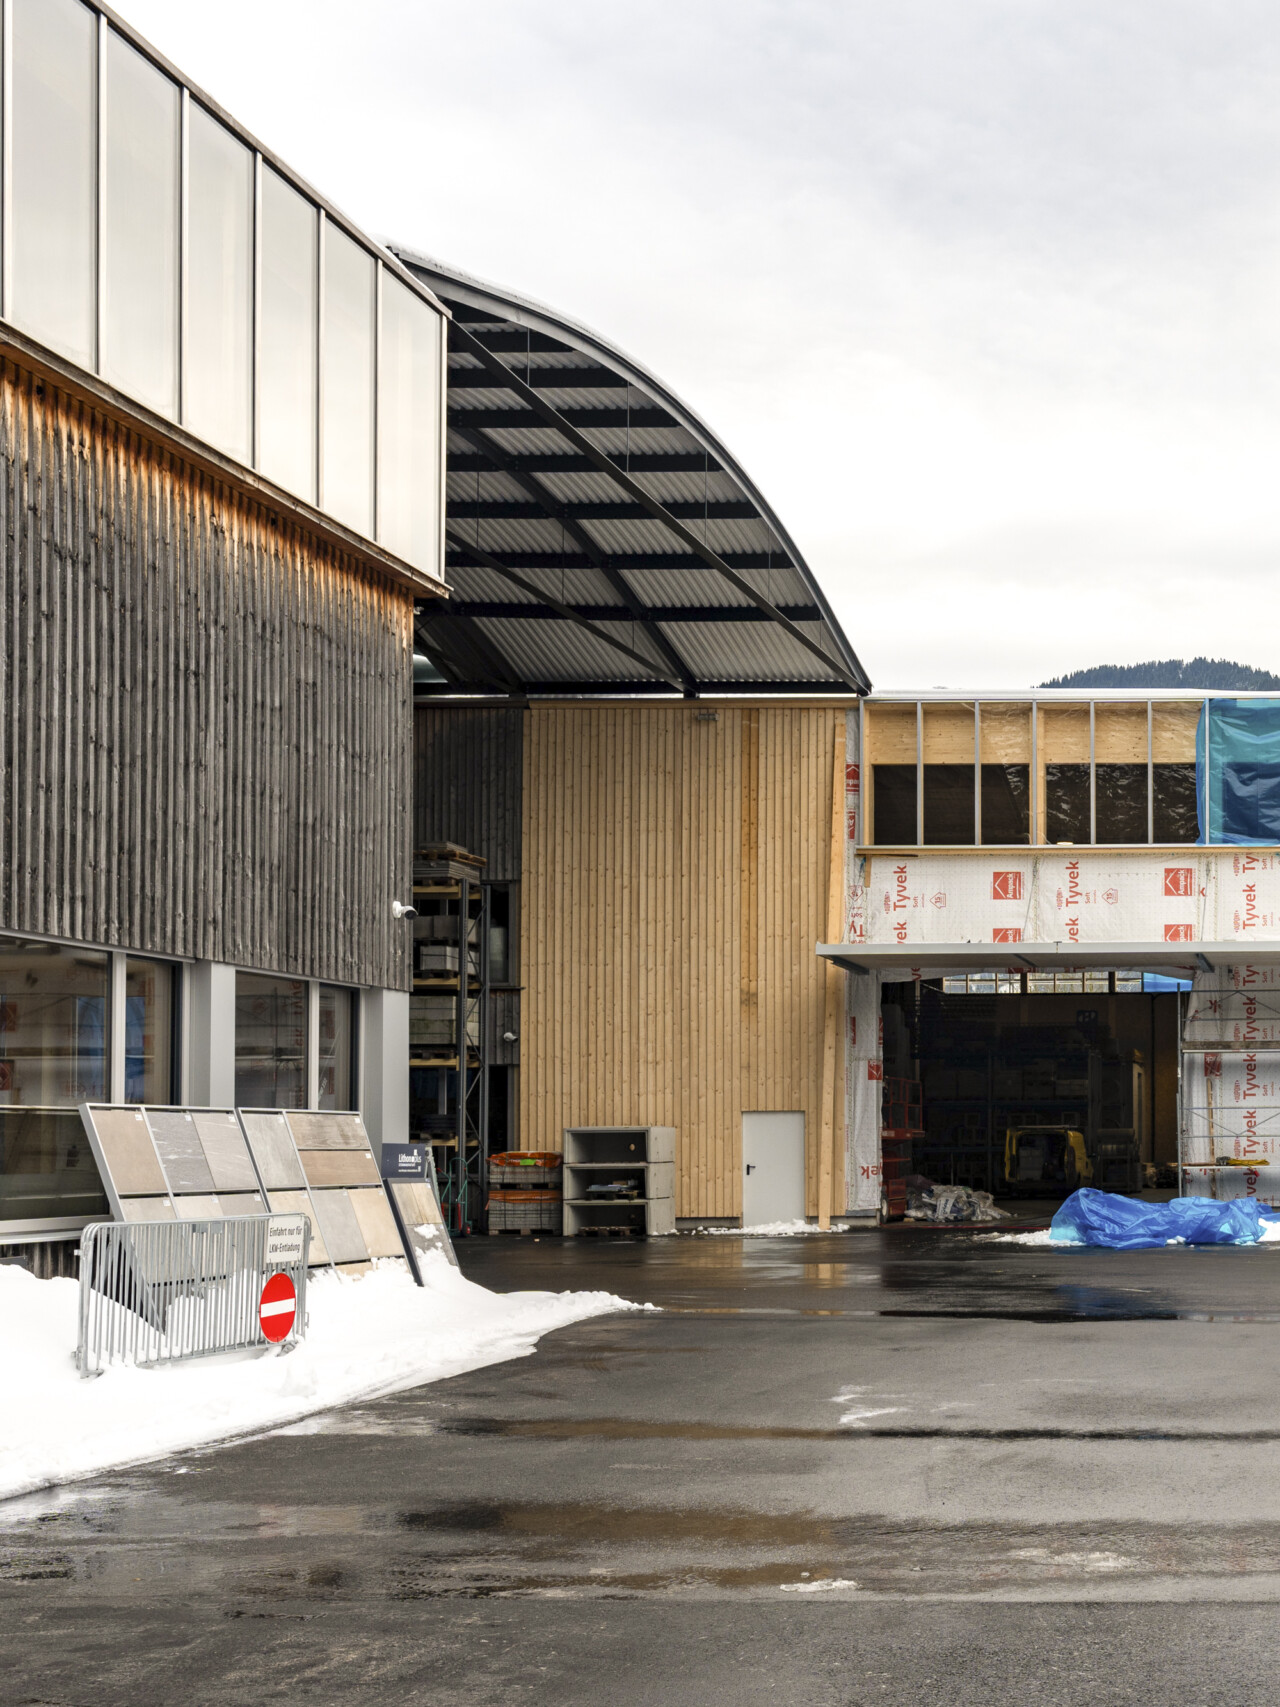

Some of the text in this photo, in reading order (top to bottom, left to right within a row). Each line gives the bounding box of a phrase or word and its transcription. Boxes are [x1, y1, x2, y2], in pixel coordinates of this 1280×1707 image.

[893, 865, 910, 911] Tyvek
[1006, 873, 1015, 898] Ampack
[1066, 861, 1082, 907] Tyvek
[1178, 869, 1187, 895] Ampack
[1243, 884, 1259, 930] Tyvek
[1065, 918, 1079, 942] vek
[1243, 997, 1260, 1041] Tyvek
[1243, 1054, 1260, 1100] Tyvek
[1243, 1110, 1260, 1156] Tyvek
[269, 1243, 300, 1253] LKW-Entladung
[270, 1227, 287, 1236] Einfahrt
